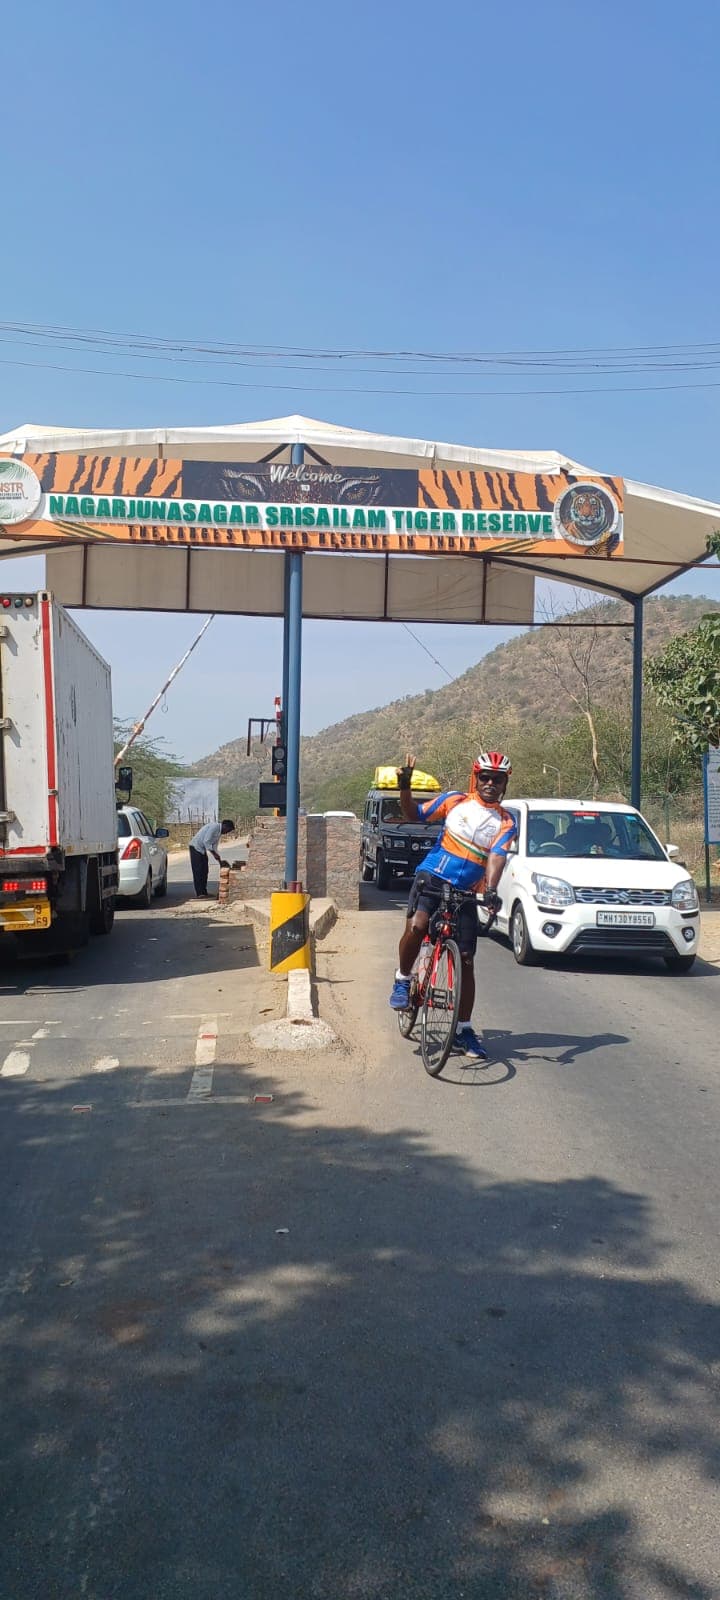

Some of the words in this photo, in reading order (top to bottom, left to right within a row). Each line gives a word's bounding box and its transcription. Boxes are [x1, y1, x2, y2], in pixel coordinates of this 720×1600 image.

[270, 464, 343, 485] Welcome
[49, 495, 259, 524] NAGARJUNASAGAR
[265, 506, 386, 528] SRISAILAM
[392, 510, 456, 530] TIGER
[462, 512, 553, 533] RESERVE
[128, 525, 158, 538] THE
[167, 527, 249, 542] LARGEST
[261, 530, 308, 545] TIGER
[319, 532, 387, 546] RESERVE
[399, 535, 414, 547] IN
[430, 536, 476, 548] INDIA
